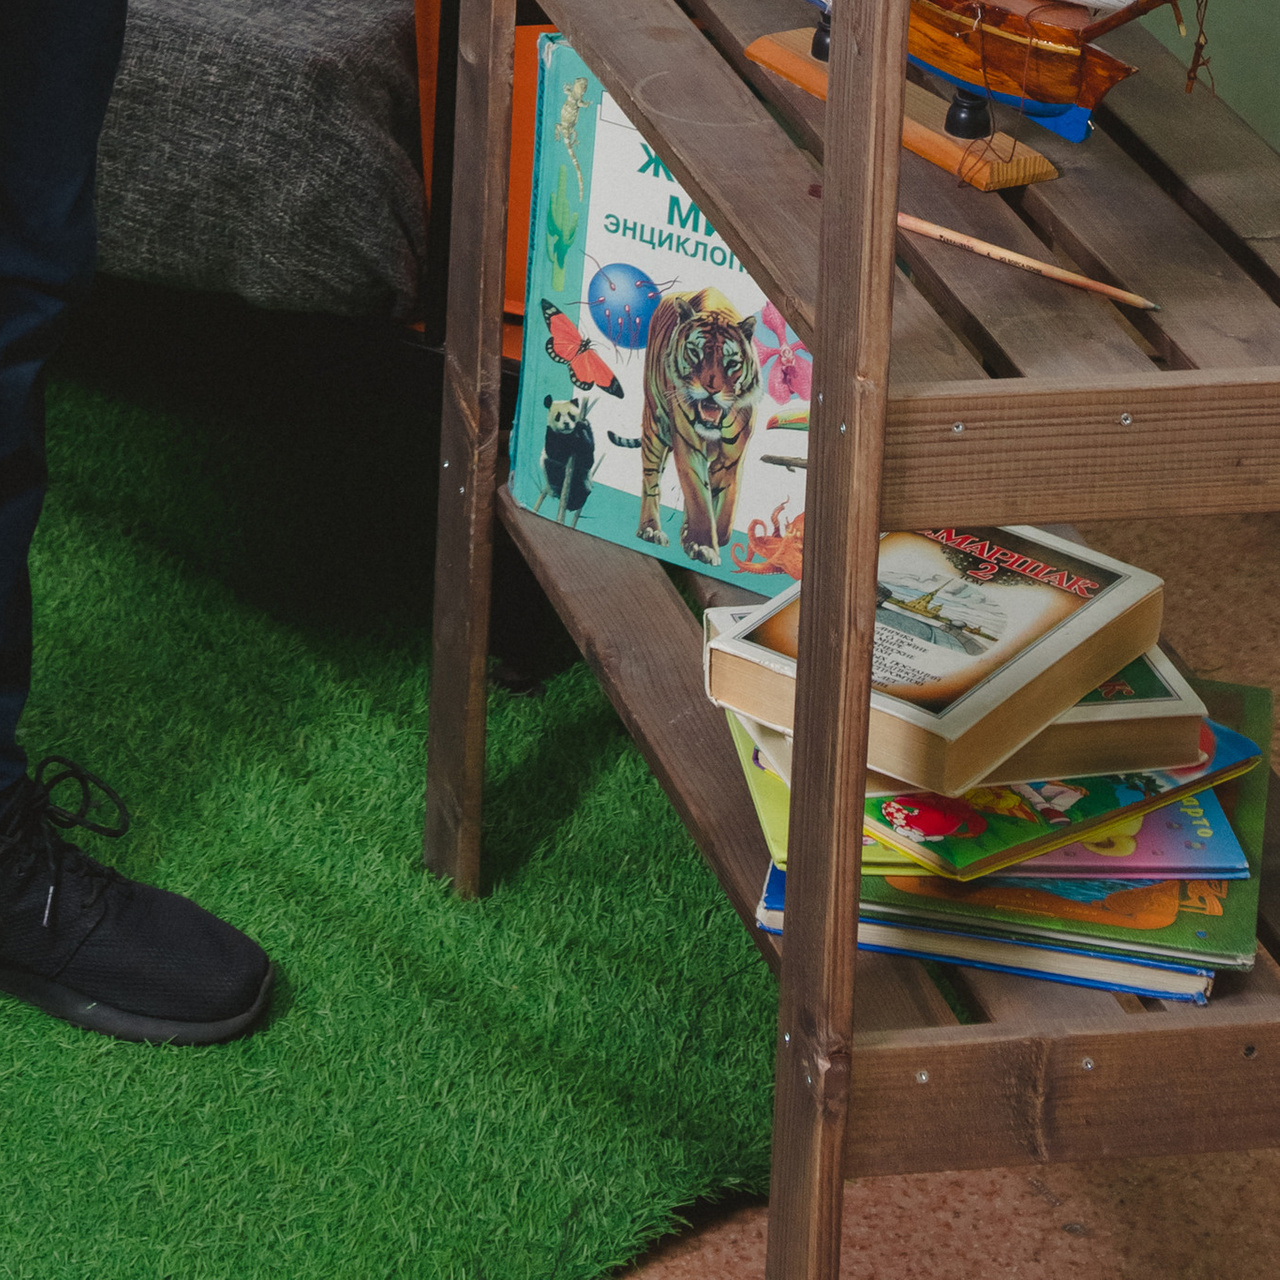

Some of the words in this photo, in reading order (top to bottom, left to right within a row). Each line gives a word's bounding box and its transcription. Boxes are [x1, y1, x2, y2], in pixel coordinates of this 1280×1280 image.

[637, 142, 674, 184] Ж
[603, 212, 750, 273] ЭНЦИКЛОП
[936, 528, 1100, 599] МАРШАК
[967, 563, 999, 581] 2
[1180, 797, 1214, 838] арто
